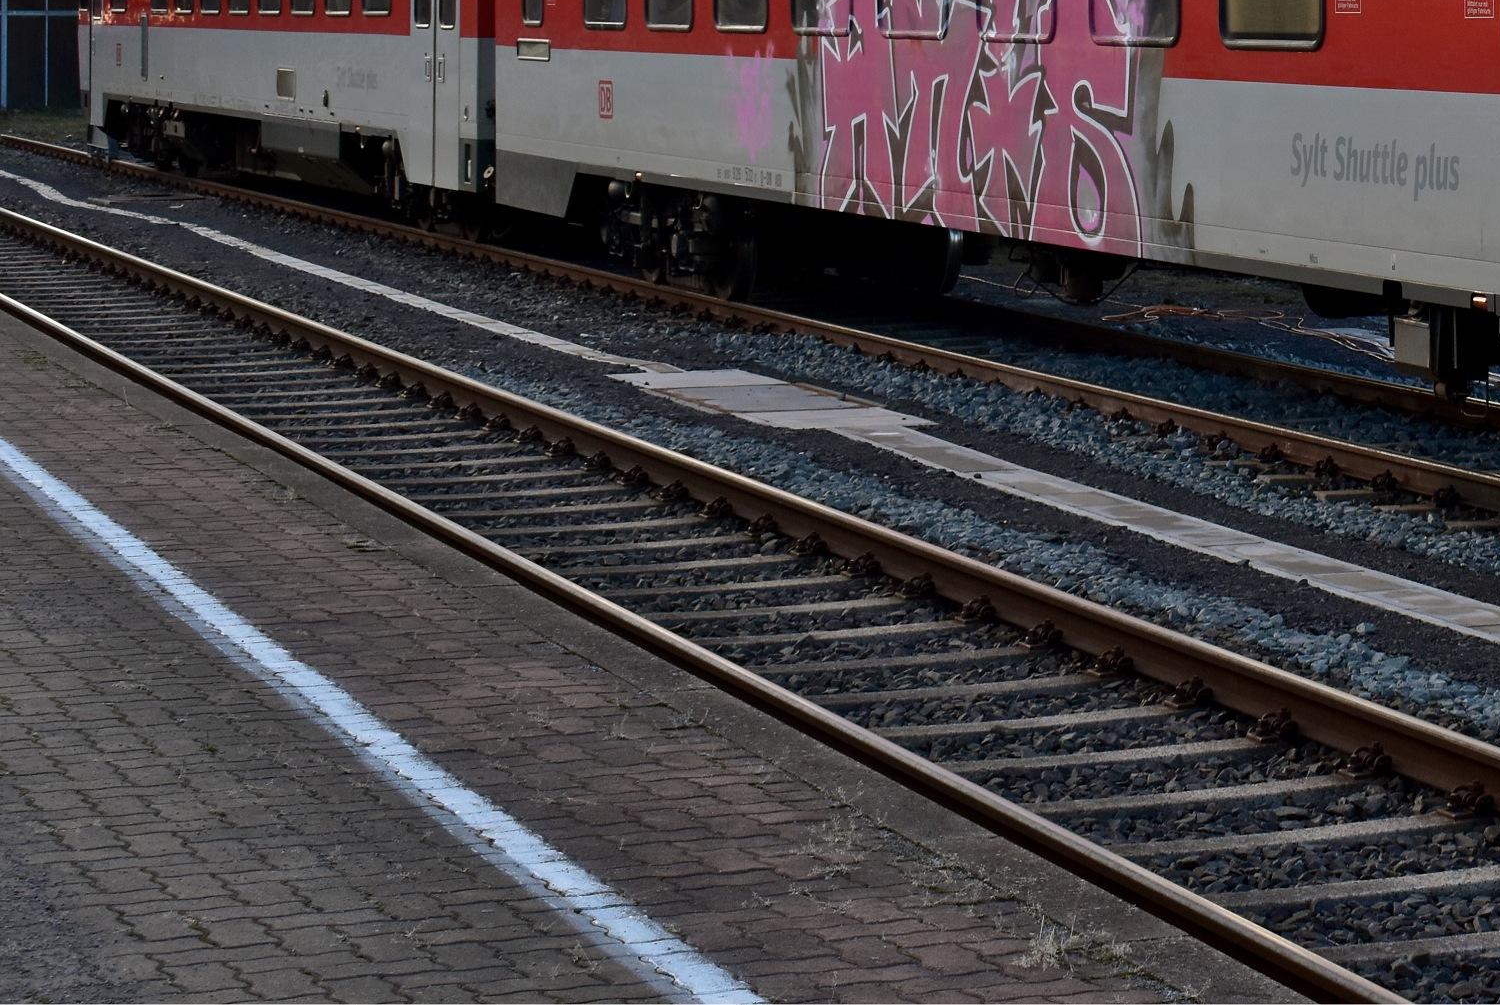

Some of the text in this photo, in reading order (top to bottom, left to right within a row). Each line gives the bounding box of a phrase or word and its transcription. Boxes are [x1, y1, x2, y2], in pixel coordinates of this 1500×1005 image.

[1290, 132, 1460, 202] Sylt Shuttle plus
